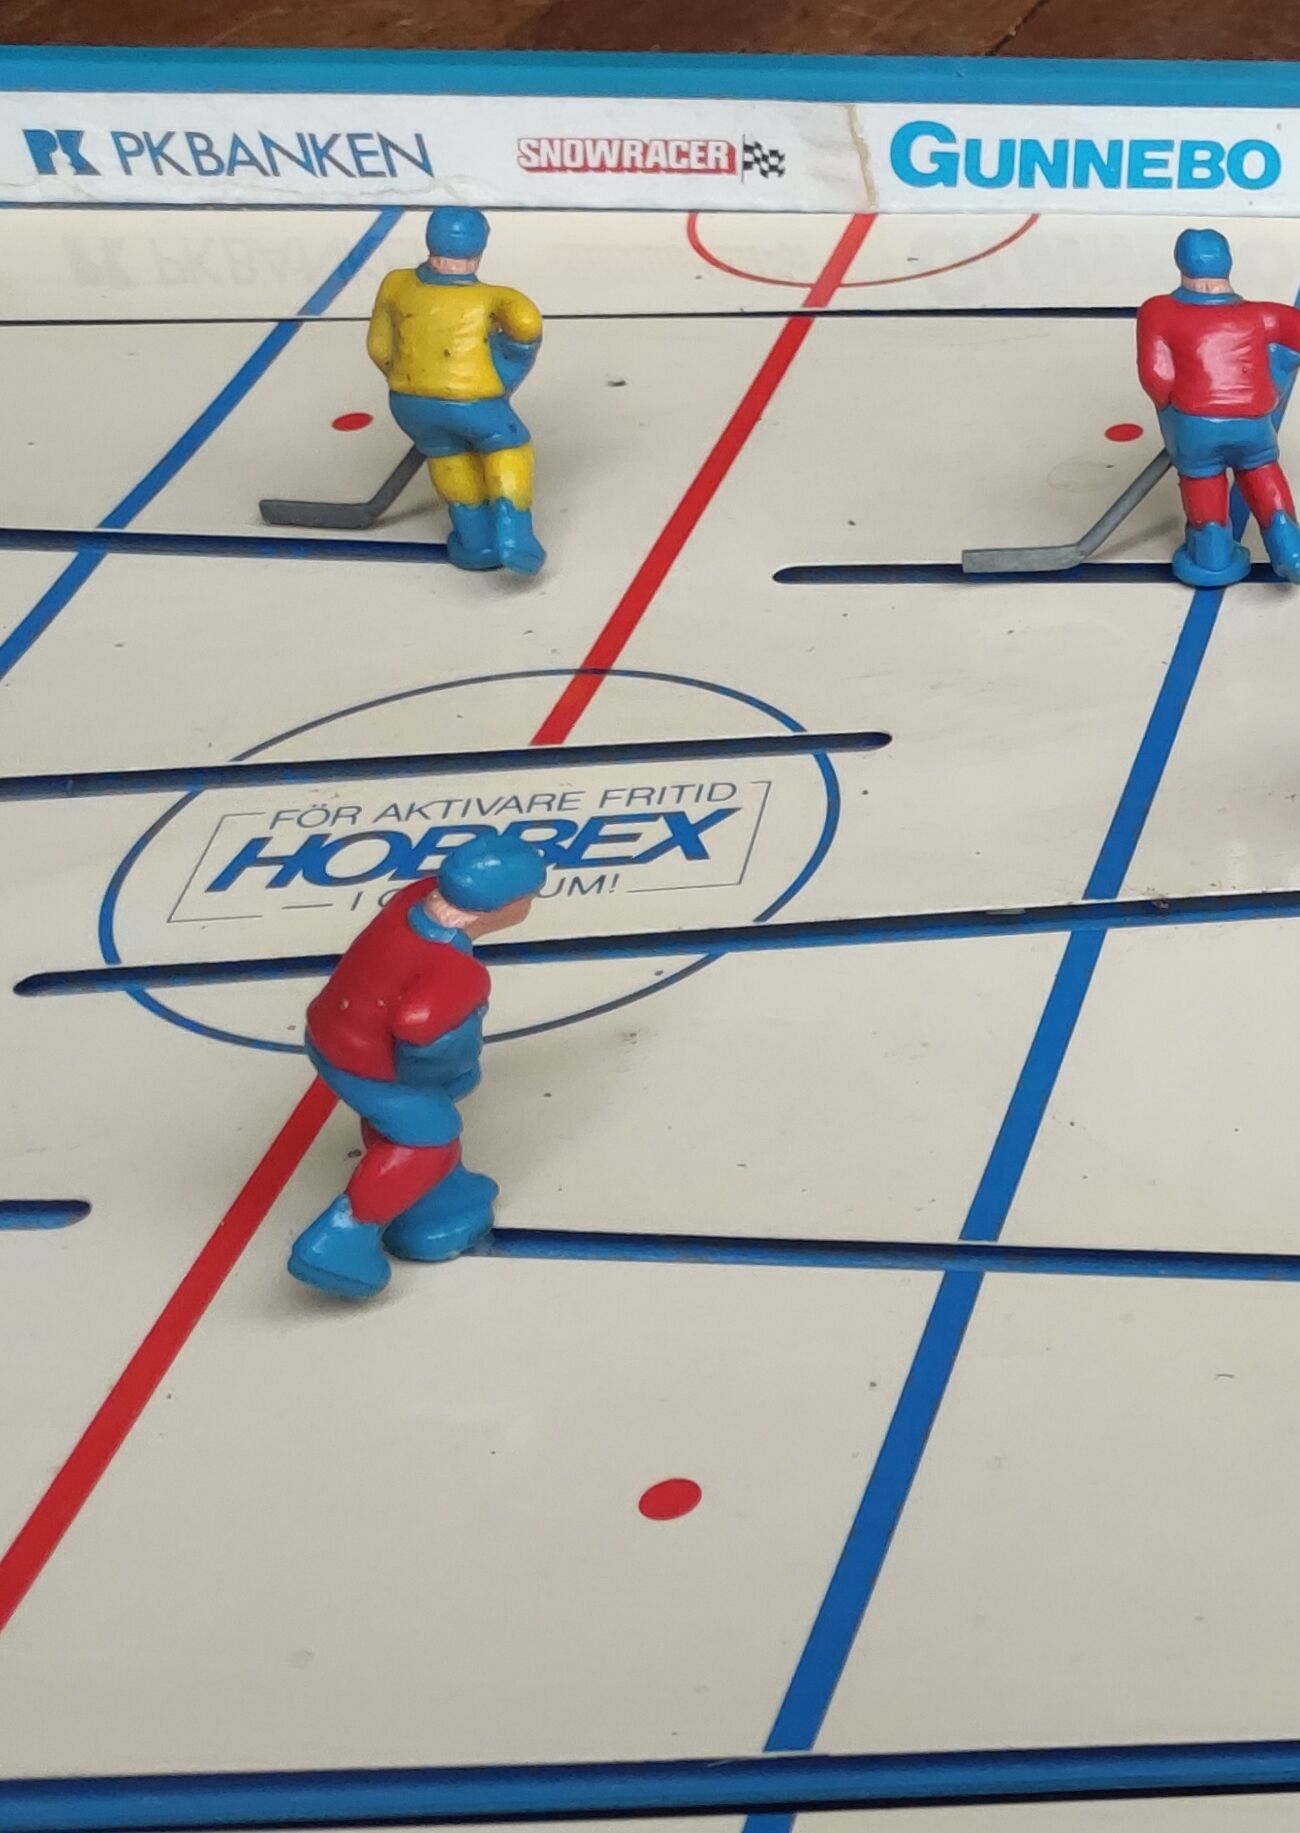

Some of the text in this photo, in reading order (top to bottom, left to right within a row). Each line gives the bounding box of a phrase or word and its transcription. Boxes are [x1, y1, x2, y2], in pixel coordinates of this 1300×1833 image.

[110, 130, 435, 178] PKBANKEN
[517, 138, 738, 176] SNOWRACER
[890, 120, 1282, 190] GUNNEBO
[269, 781, 737, 830] FÖR AKTIVARE FRITID
